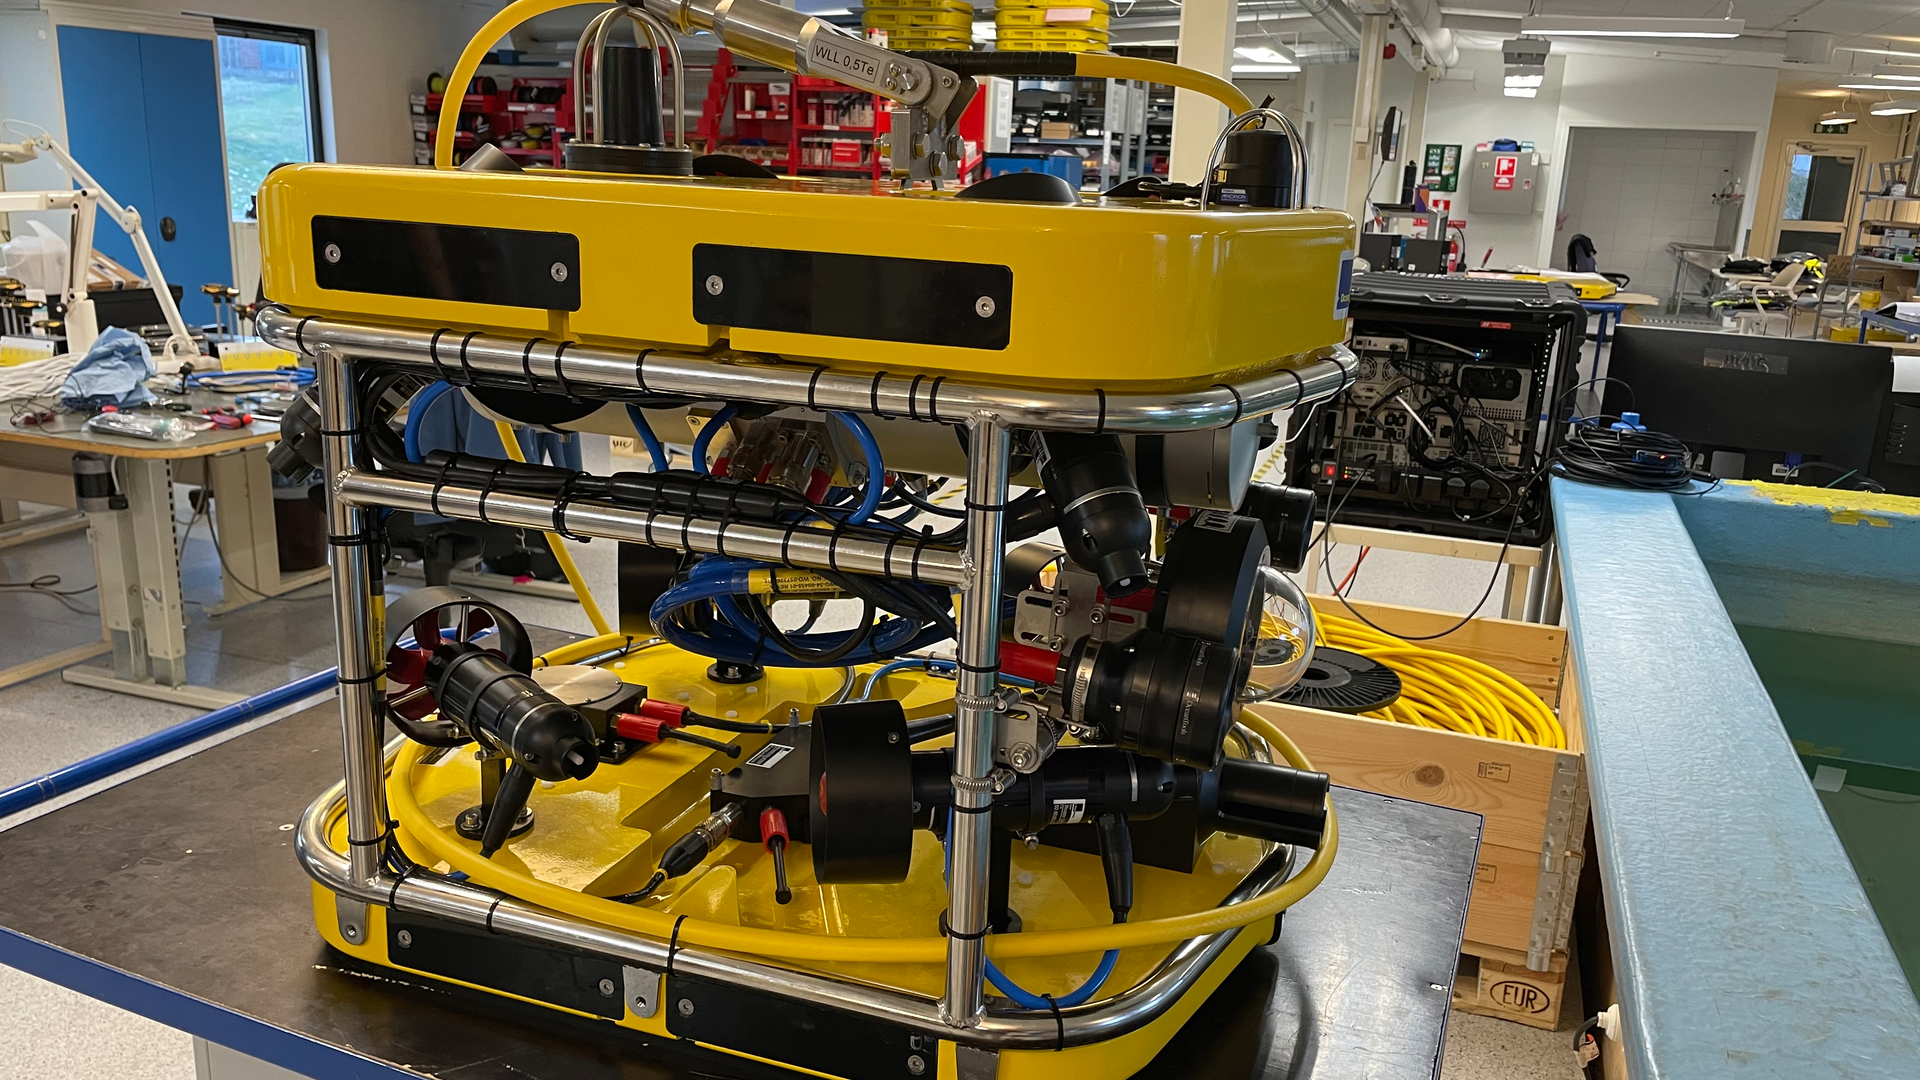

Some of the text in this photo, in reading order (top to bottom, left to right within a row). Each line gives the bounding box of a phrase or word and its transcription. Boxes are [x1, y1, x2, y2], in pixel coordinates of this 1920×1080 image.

[815, 44, 874, 76] WLL 0,5Te
[1181, 700, 1194, 735] OceanTools
[1502, 984, 1538, 1010] EUR
